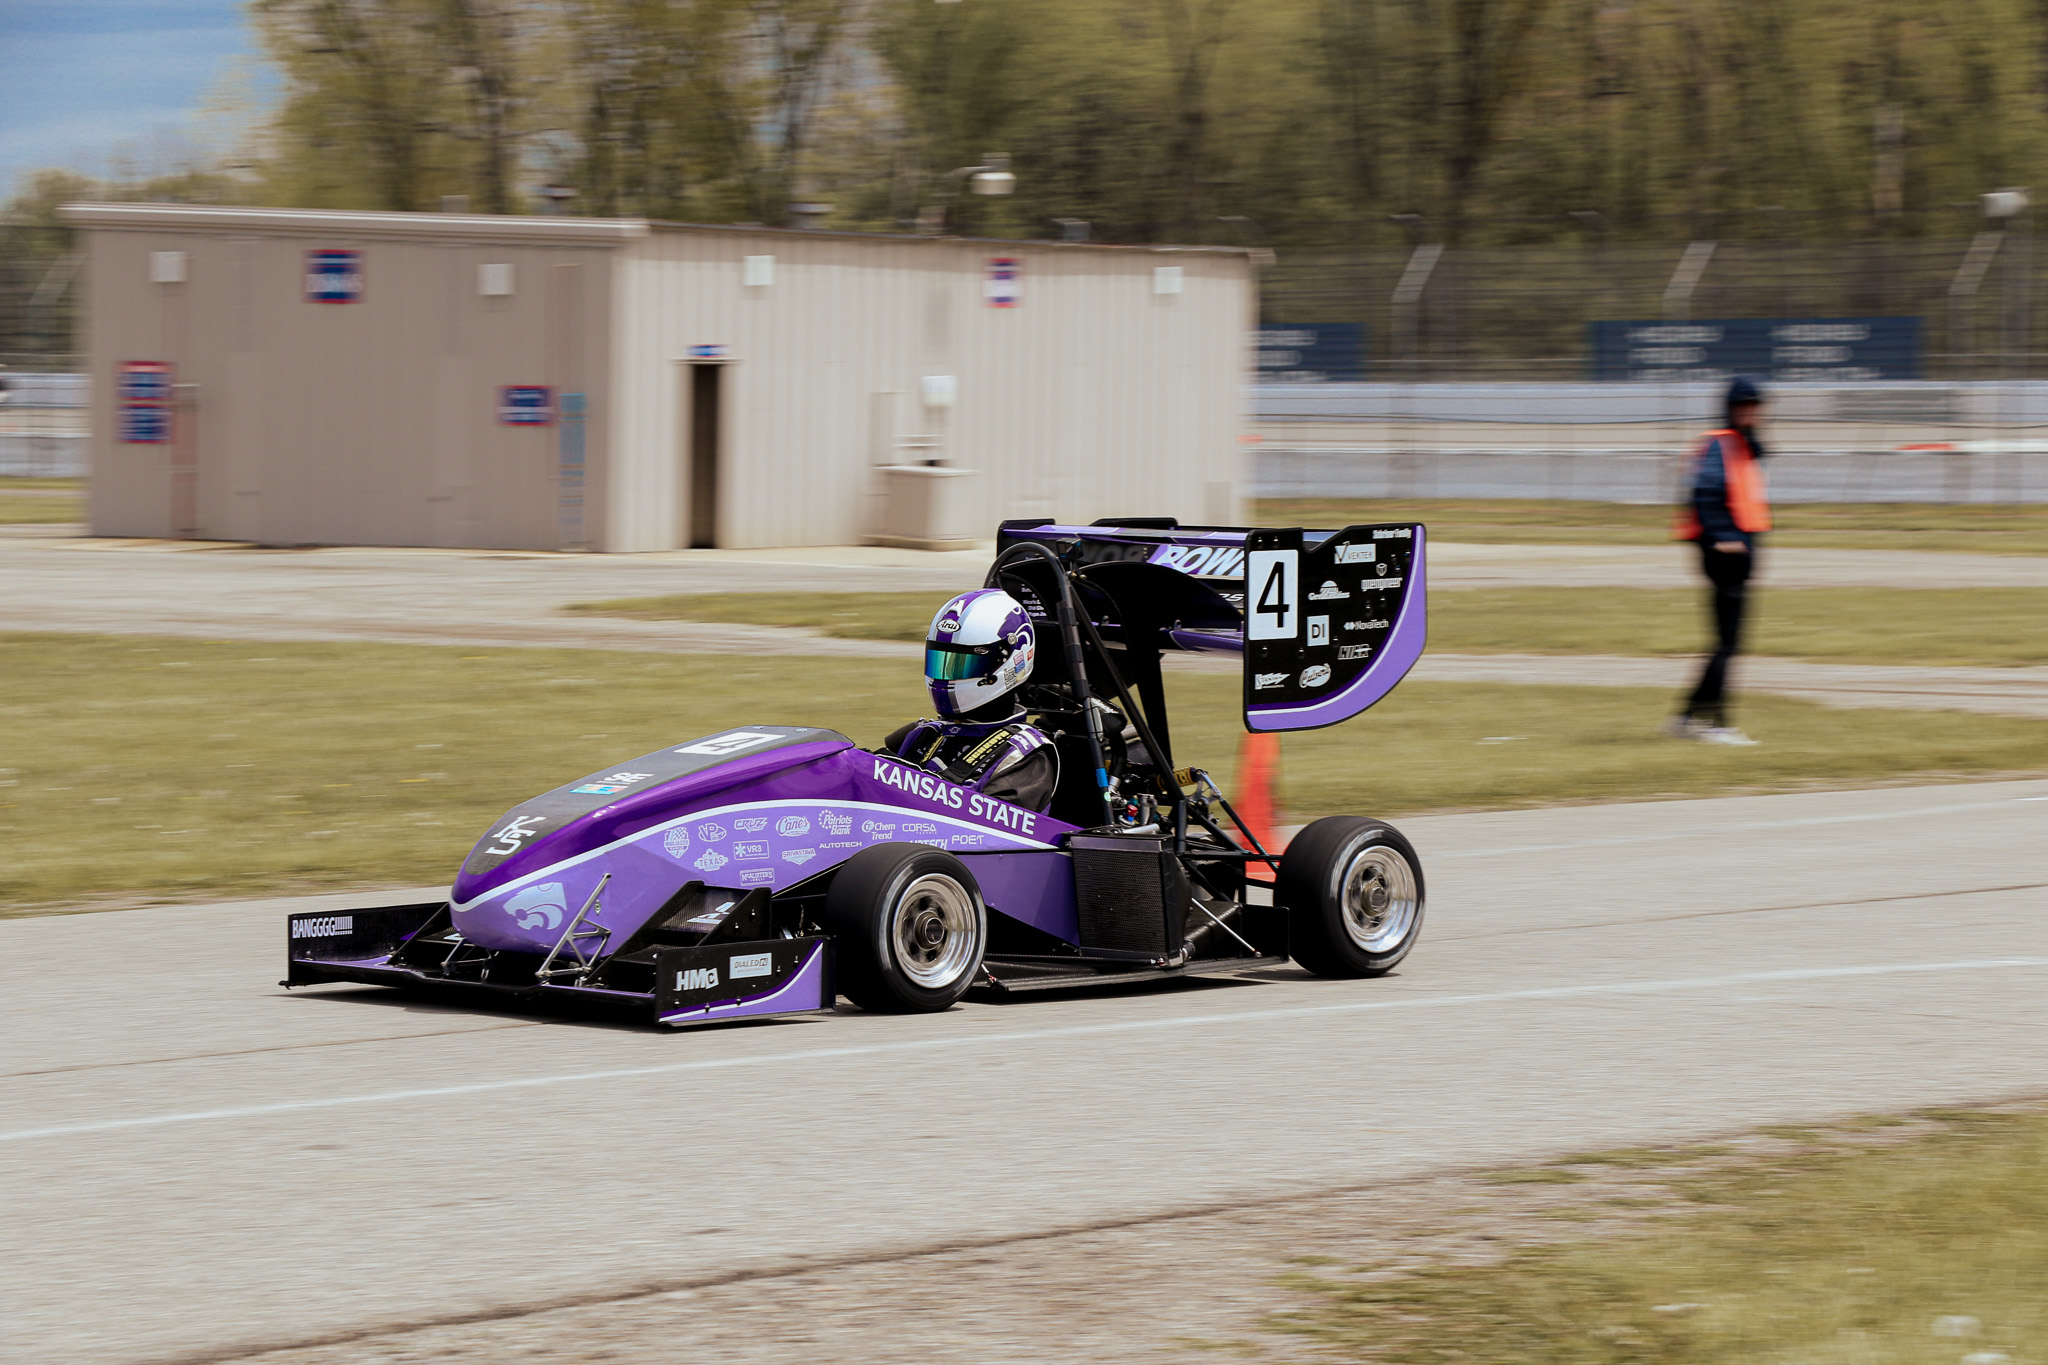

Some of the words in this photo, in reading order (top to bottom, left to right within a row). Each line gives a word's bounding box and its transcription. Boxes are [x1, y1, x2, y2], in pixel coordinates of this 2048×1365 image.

[1256, 561, 1290, 628] 4
[1311, 624, 1325, 639] DI
[873, 759, 964, 809] KANSAS
[968, 793, 1037, 836] STATE
[823, 813, 853, 825] Patriots
[830, 825, 851, 836] Bank
[873, 821, 896, 832] Chem
[901, 822, 937, 833] CORSA
[871, 831, 893, 841] Trend
[951, 834, 985, 845] POET
[746, 844, 763, 853] VR3
[818, 841, 863, 849] AUTOTECH
[699, 856, 724, 867] TEXAS
